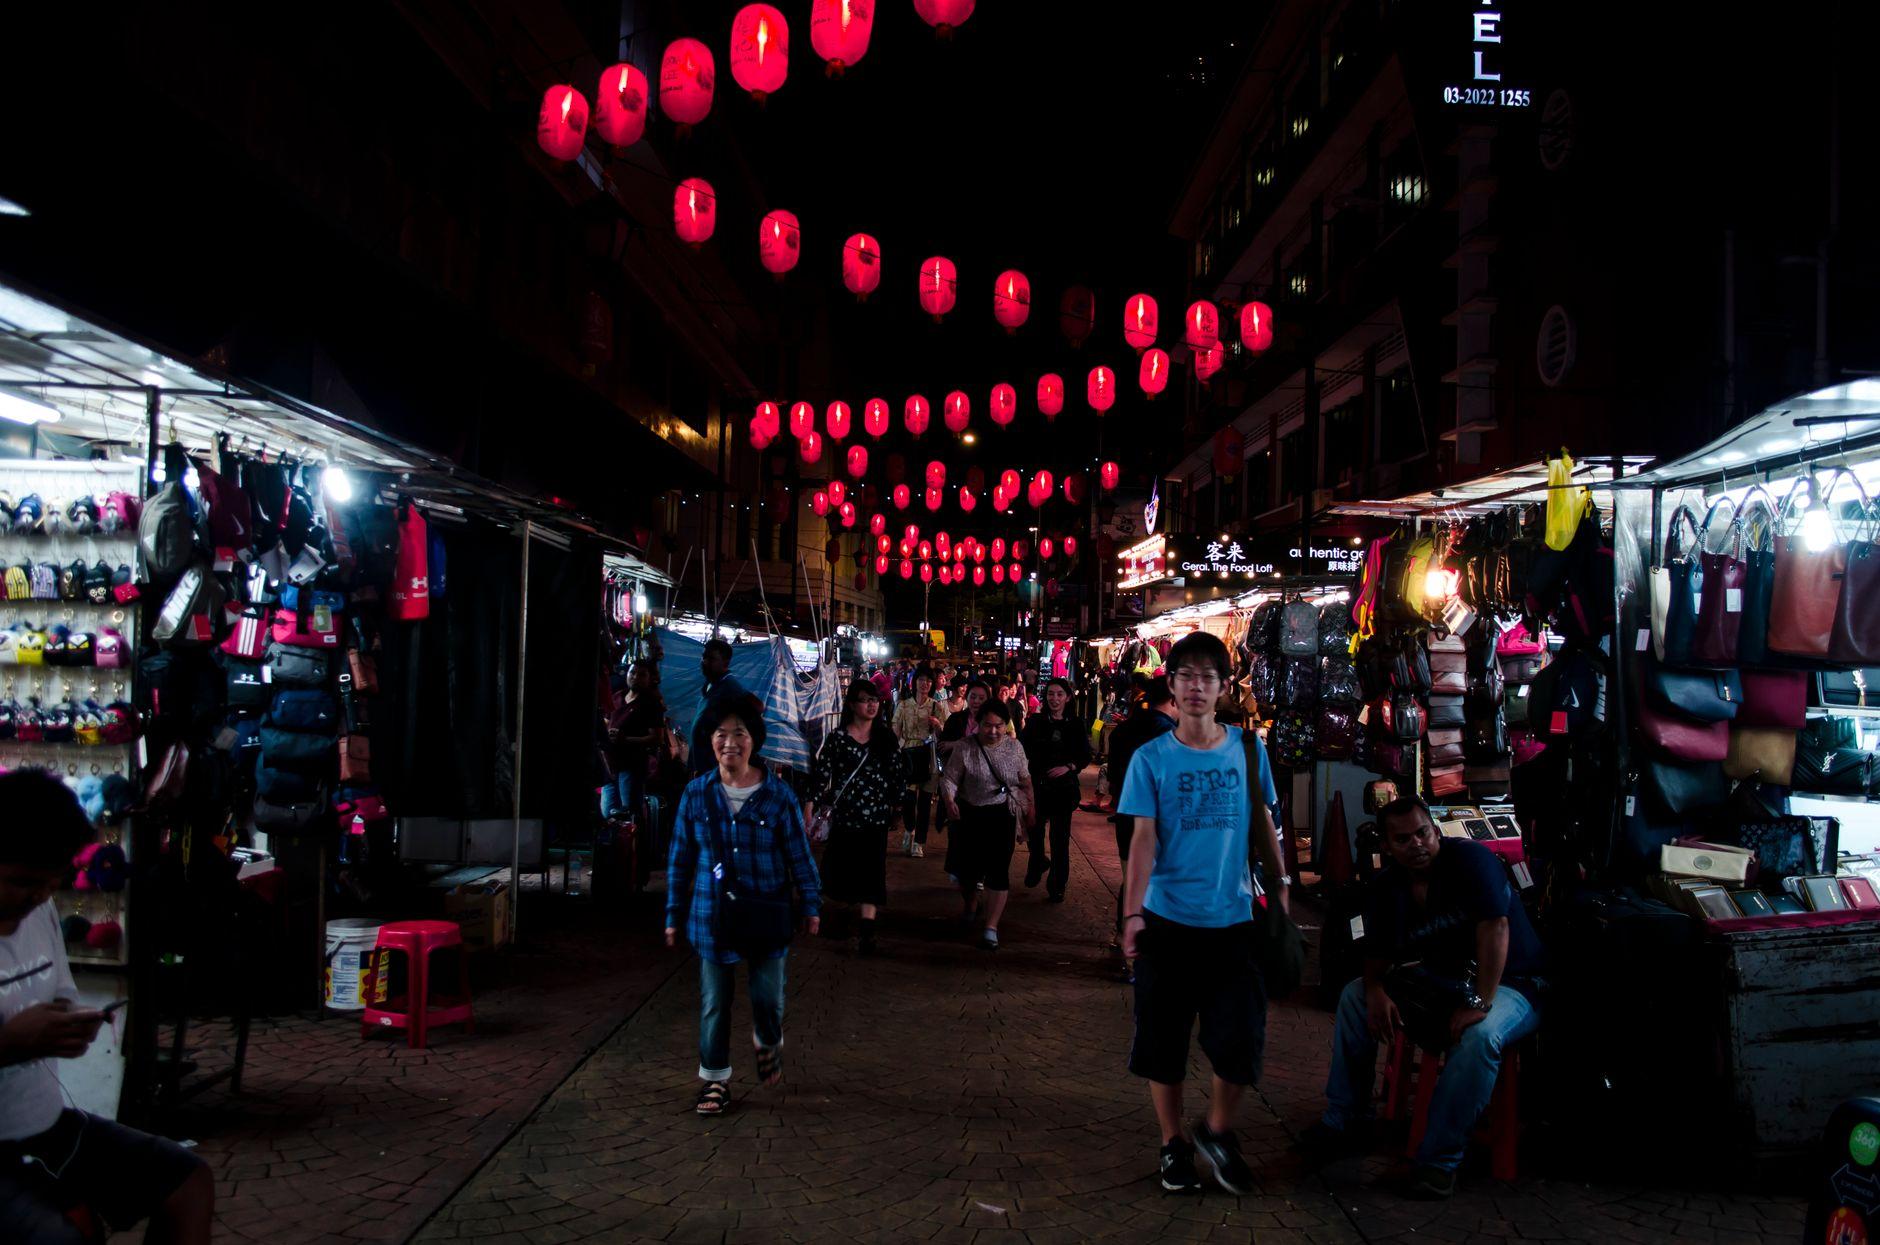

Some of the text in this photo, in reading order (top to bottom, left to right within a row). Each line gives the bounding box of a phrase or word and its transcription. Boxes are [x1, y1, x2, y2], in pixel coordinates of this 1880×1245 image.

[1473, 0, 1501, 81] EL
[1443, 86, 1531, 107] 03-2022 1255
[1205, 541, 1247, 562] 客来
[1289, 546, 1348, 559] auhentic
[1181, 561, 1274, 573] Gerai. The Food Loft
[160, 571, 200, 628] NIKE
[1177, 767, 1240, 793] BIRD
